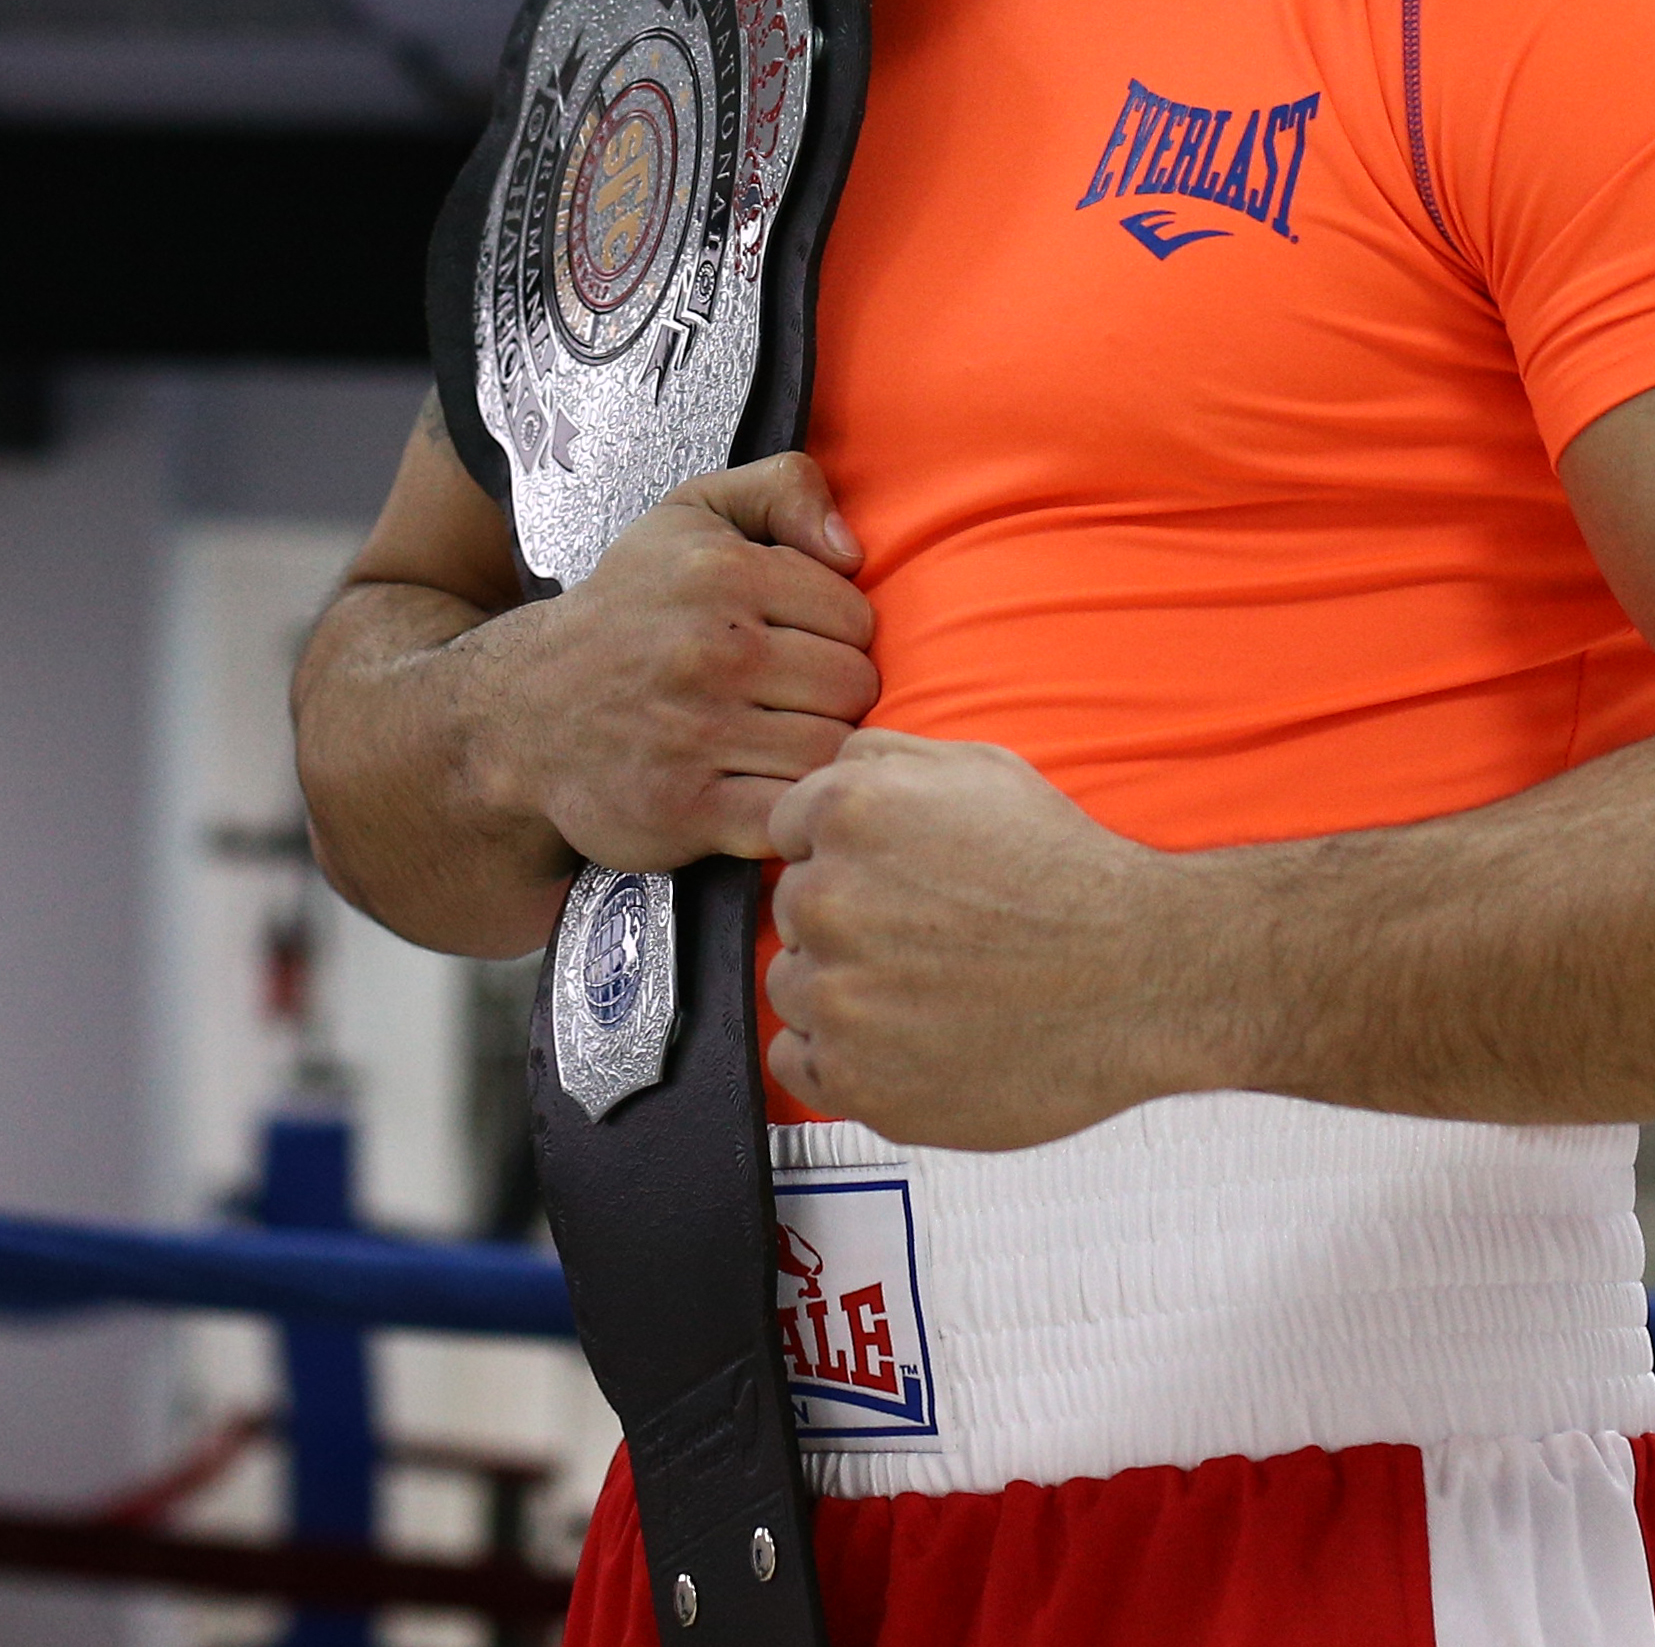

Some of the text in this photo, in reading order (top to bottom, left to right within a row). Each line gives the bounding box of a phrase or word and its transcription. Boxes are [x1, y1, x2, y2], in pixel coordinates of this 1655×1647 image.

[595, 119, 648, 271] SFC
[703, 3, 736, 252] NATIONAL
[1075, 77, 1321, 238] EVERLAST
[495, 147, 533, 418] CHAMPION
[524, 153, 553, 368] ROMANIA
[777, 1281, 900, 1396] ALE
